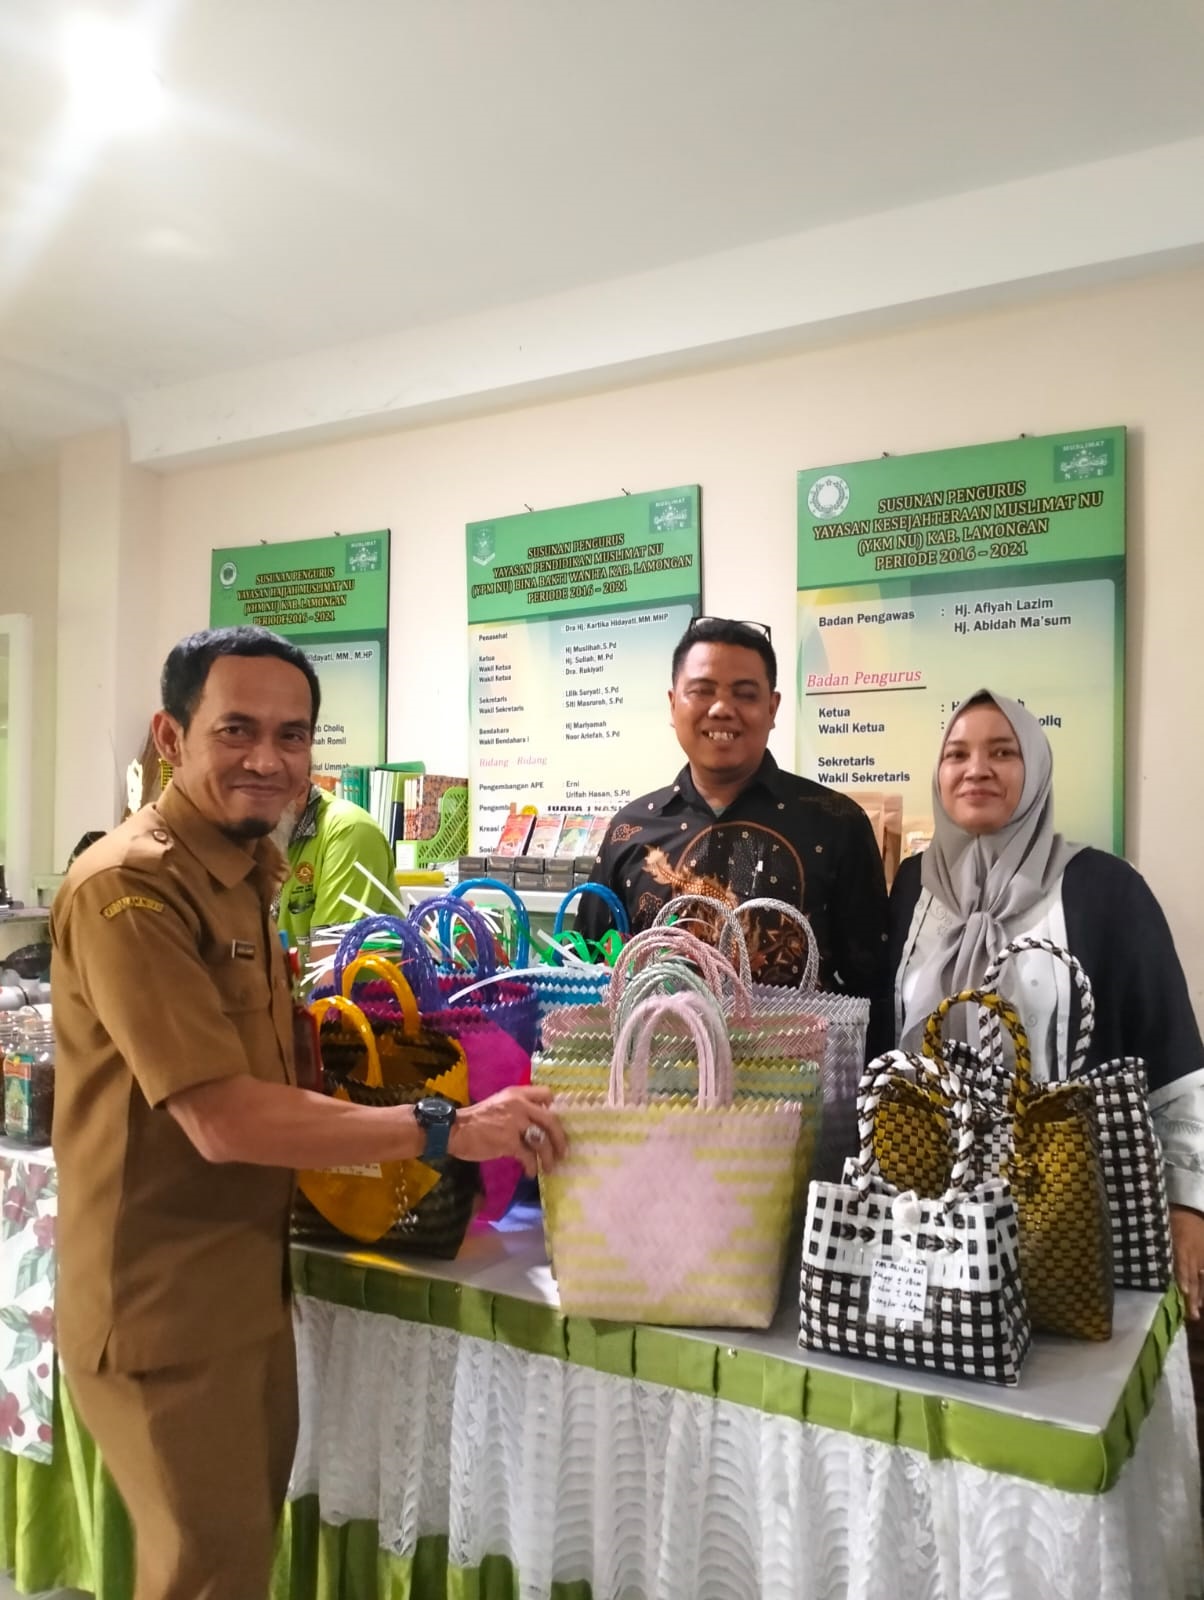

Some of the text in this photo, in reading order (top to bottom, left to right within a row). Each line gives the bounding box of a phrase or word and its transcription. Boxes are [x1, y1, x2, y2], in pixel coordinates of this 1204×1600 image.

[878, 481, 1026, 513] SUSUNAN PENGURUS
[814, 491, 1103, 540] YAYASAN KESEJAHTERAAN MUSLIMAT NU
[528, 533, 624, 559] SUSUNAN PENGURUS
[858, 519, 1048, 556] (YKM NU) KAB. LAMONGAN
[493, 543, 664, 579] YAYASAN PENDIDIKAN MUSLIMAT NU
[875, 551, 936, 570] PERIODE
[940, 547, 975, 562] 2016
[991, 541, 1027, 558] 2021
[256, 567, 335, 585] SUSUNAN PENGURUS
[472, 555, 692, 598] (YPM NU) BINA BAKTI WANITA KAB. LAMONGAN
[299, 581, 342, 595] MUSLIMAT
[343, 579, 355, 590] NU
[527, 588, 568, 604] PERIODE
[570, 584, 593, 598] 2016
[603, 580, 627, 594] 2021
[300, 595, 347, 609] LAMONGAN
[253, 613, 287, 626] PERIODE
[819, 615, 853, 627] Badan
[857, 610, 915, 626] Pengawas
[955, 604, 971, 617] Hj.
[974, 600, 1013, 615] Afiyah
[1016, 598, 1053, 611] Lazim
[479, 632, 508, 641] Penasehat
[587, 620, 609, 630] Kartika
[954, 621, 970, 634] Hj.
[974, 618, 1016, 631] Abidah
[579, 665, 604, 675] Rukiyati
[806, 669, 922, 688] Badan Pengurus
[495, 705, 524, 713] Sekretaris
[819, 707, 850, 718] Ketua
[819, 723, 849, 734] Wakil
[852, 722, 885, 733] Ketua
[495, 736, 526, 744] Bendahara
[818, 756, 875, 767] Sekretaris
[818, 771, 910, 783] Wakil Sekretaris
[479, 783, 528, 792] Pengembangan
